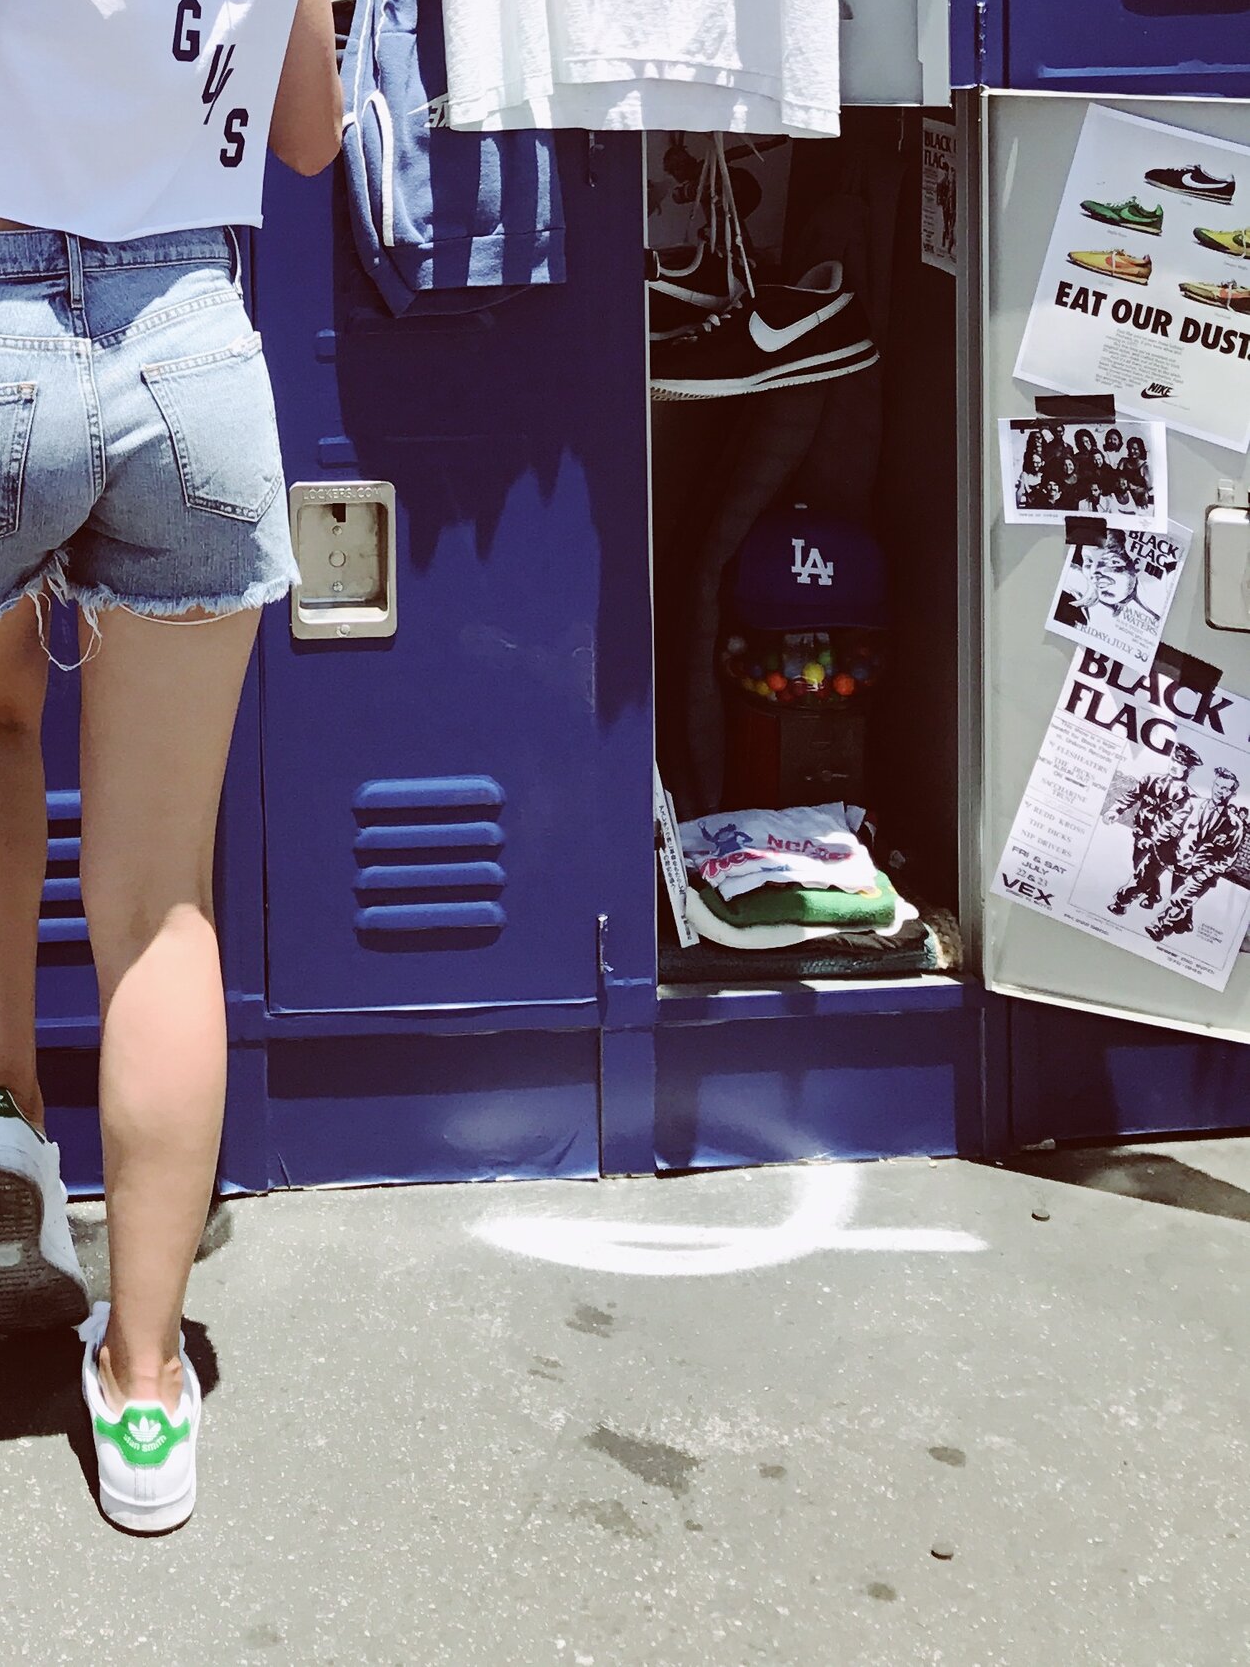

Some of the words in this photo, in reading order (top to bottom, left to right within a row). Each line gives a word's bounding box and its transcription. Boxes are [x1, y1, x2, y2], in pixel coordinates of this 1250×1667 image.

[1054, 280, 1108, 318] EAT
[1111, 298, 1174, 339] OUR
[1147, 381, 1174, 397] NIKE
[1128, 530, 1179, 559] BLACK
[791, 538, 834, 586] LA
[1134, 648, 1150, 663] 30
[1078, 645, 1234, 735] BLACK
[1065, 680, 1178, 757] FLAG
[1012, 845, 1030, 858] FRI
[1043, 860, 1067, 875] SAT
[1021, 860, 1050, 876] JULY
[1001, 872, 1055, 907] VEX
